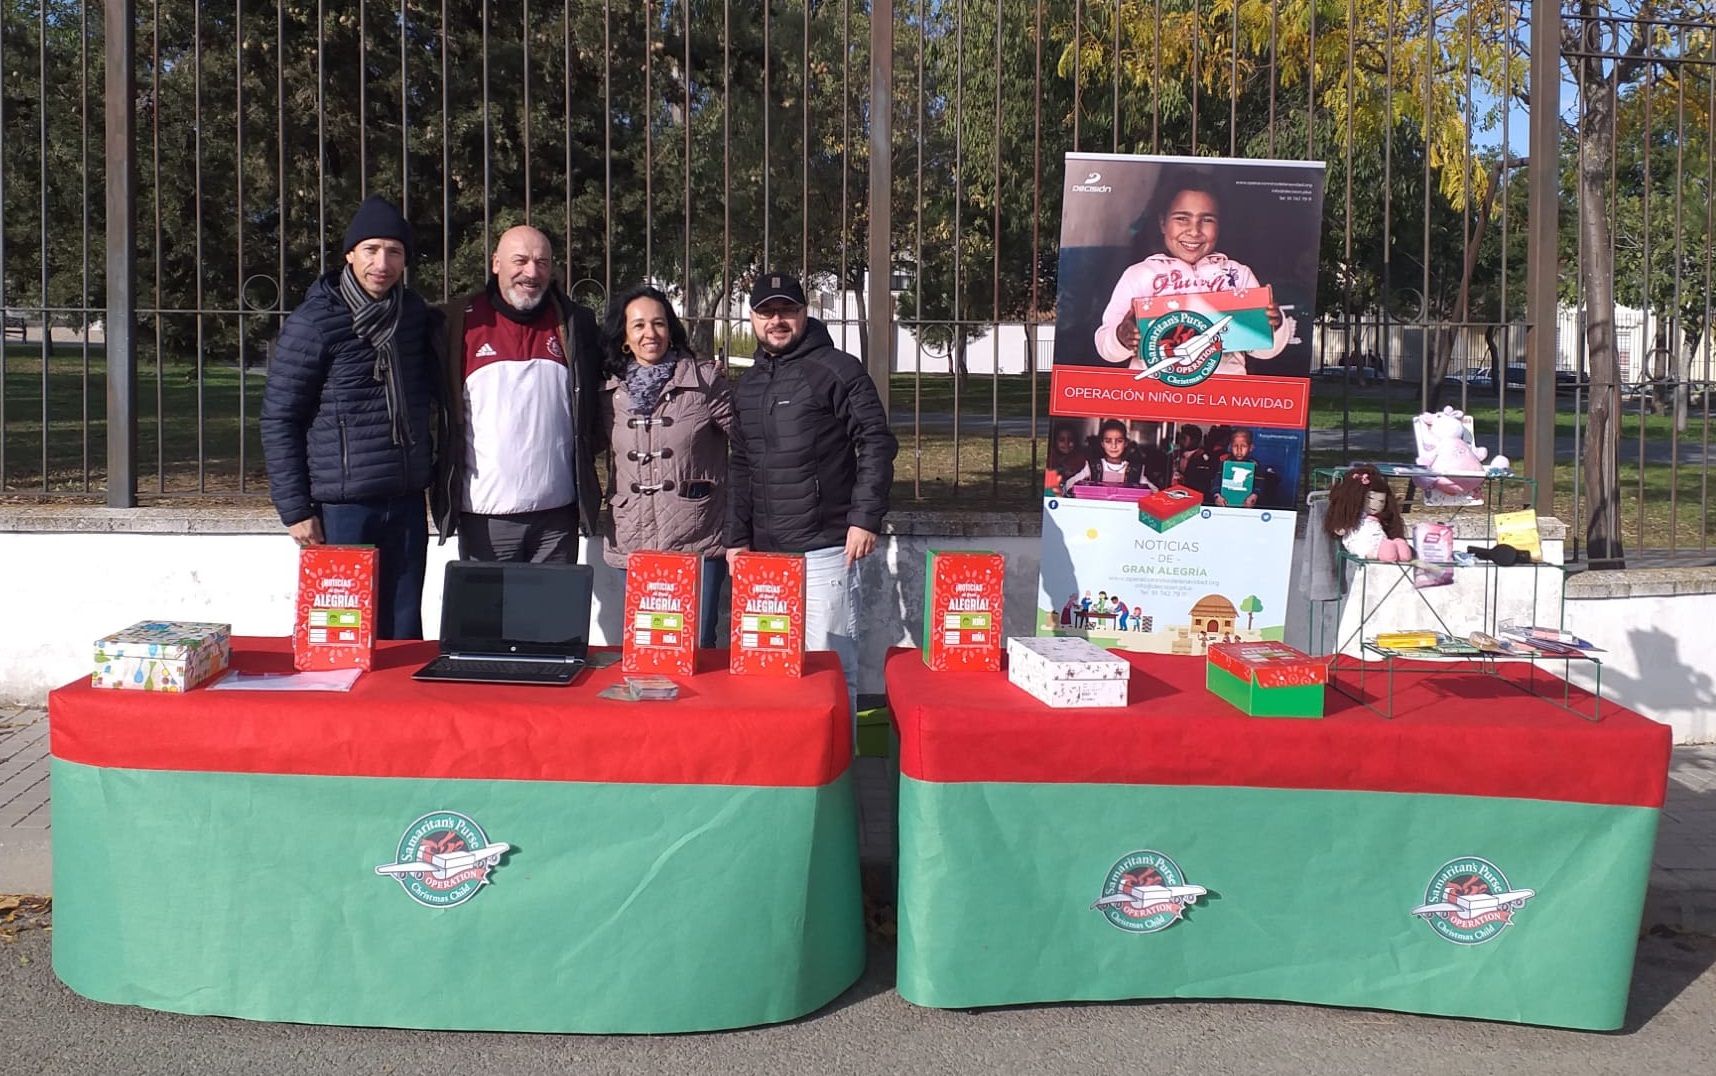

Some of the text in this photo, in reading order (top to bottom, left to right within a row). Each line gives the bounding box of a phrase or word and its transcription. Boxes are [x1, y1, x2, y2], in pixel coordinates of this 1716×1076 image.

[1147, 312, 1207, 365] Samaritan's Purse
[1176, 345, 1217, 373] OPERATION
[1167, 359, 1217, 385] Christmas Child
[1064, 386, 1294, 410] OPERACIÓN NIÑO DE LA NAVIDAD
[1134, 539, 1199, 552] NOTICIAS
[1158, 554, 1173, 563] DE
[1122, 565, 1154, 574] GRAN
[313, 592, 359, 608] ALEGRÍA!
[638, 596, 682, 612] ALEGRÍA!
[745, 597, 787, 613] ALEGRÍA!
[948, 595, 989, 611] ALEGRÍA!
[401, 817, 479, 862] Samaritan's Purse
[425, 870, 477, 889] OPERATION
[1155, 857, 1176, 885] Purse
[1428, 862, 1502, 903] Samaritan's Purse
[411, 882, 471, 902] Christmas Child
[1123, 903, 1173, 918] OPERATION
[1144, 914, 1165, 928] Child
[1450, 912, 1501, 928] OPERATION
[1437, 921, 1496, 941] Christmas Child
